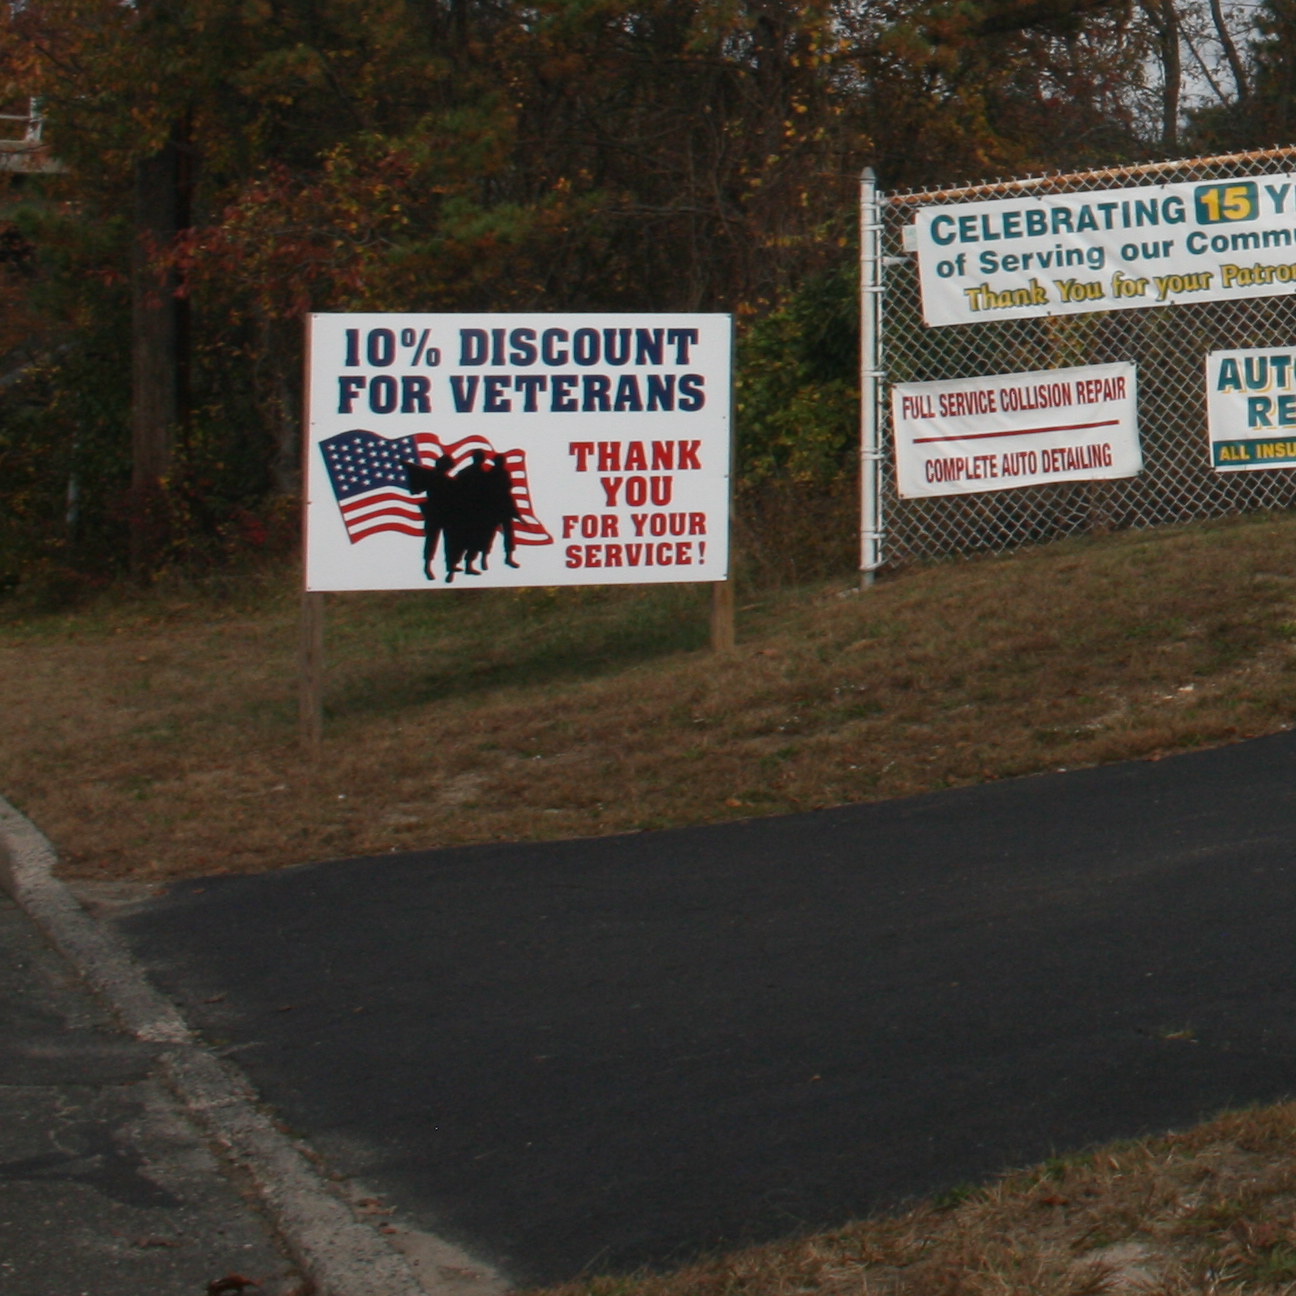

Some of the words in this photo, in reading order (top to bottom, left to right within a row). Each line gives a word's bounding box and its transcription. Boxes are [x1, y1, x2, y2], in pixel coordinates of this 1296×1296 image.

[930, 195, 1186, 245] CELEBRATING
[1200, 186, 1251, 221] 15
[936, 253, 967, 278] of
[979, 244, 1105, 274] Serving
[1121, 240, 1174, 261] our
[963, 278, 1049, 312] Thank
[1053, 278, 1105, 302] You
[1111, 271, 1149, 298] for
[1153, 272, 1214, 302] your
[344, 328, 441, 367] 10%
[459, 328, 699, 366] DISCOUNT
[337, 375, 432, 414] FOR
[449, 374, 706, 413] VETERANS
[902, 395, 935, 420] FULL
[939, 389, 997, 417] SERVICE
[1000, 382, 1072, 412] COLLISION
[1076, 376, 1126, 405] REPAIR
[569, 440, 702, 472] THANK
[925, 454, 998, 483] COMPLETE
[1002, 450, 1037, 477] AUTO
[1042, 443, 1112, 473] DETAILING
[1219, 445, 1249, 461] ALL
[600, 476, 673, 507] YOU
[562, 515, 620, 539] FOR
[631, 512, 707, 536] YOUR
